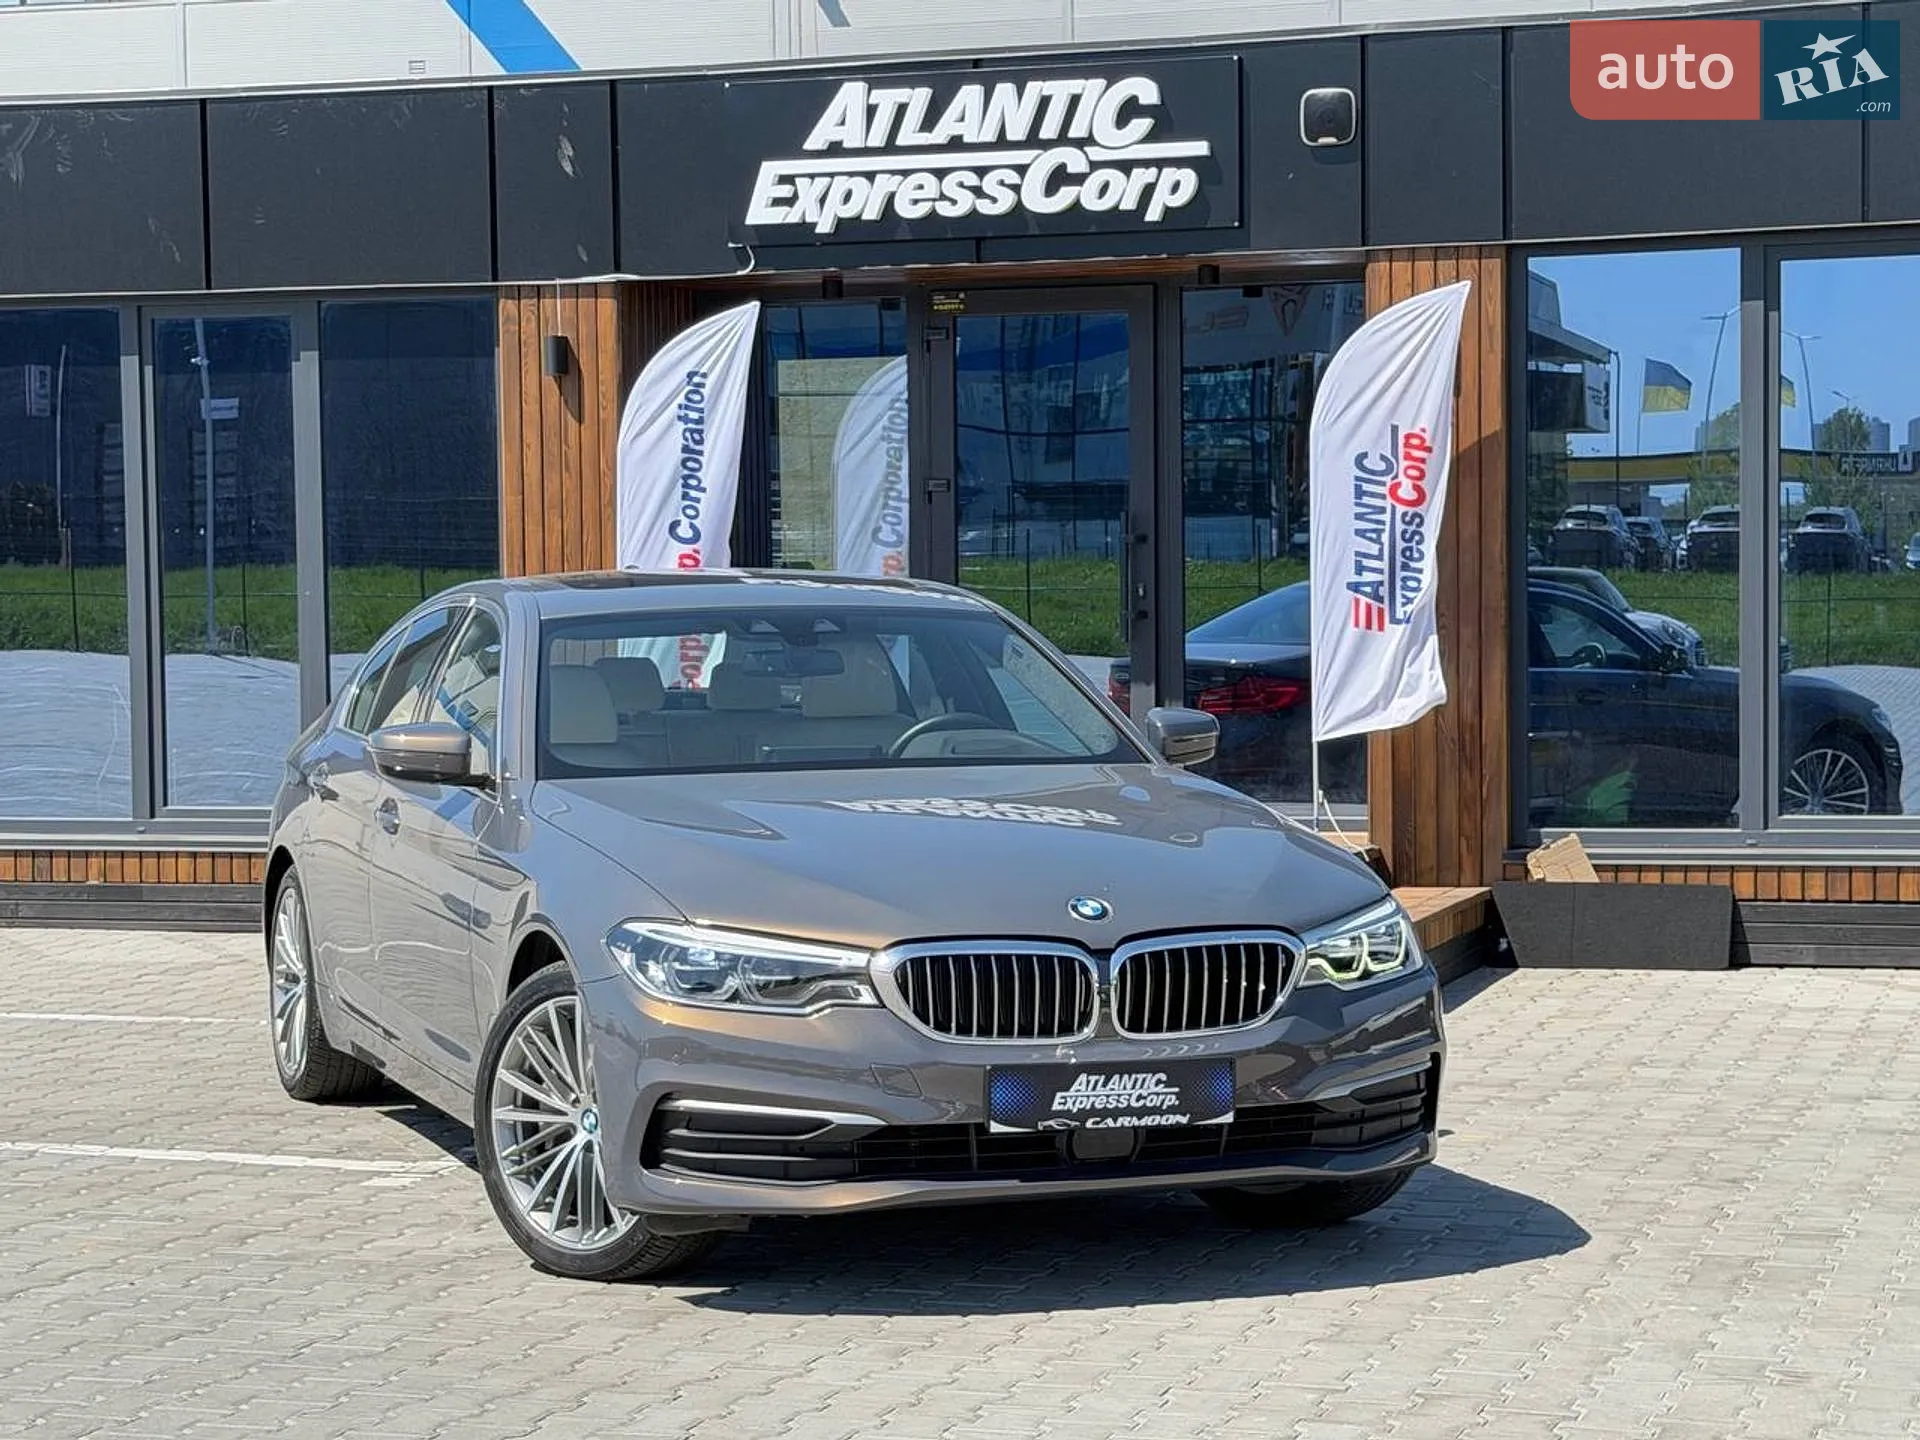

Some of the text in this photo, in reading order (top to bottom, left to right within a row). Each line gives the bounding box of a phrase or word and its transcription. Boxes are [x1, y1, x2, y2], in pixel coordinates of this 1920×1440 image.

[803, 76, 1162, 150] ATLANTIC
[668, 369, 708, 546] Corporation
[1346, 450, 1395, 604] ATLANTIC
[1069, 1072, 1168, 1092] ATLANTIC
